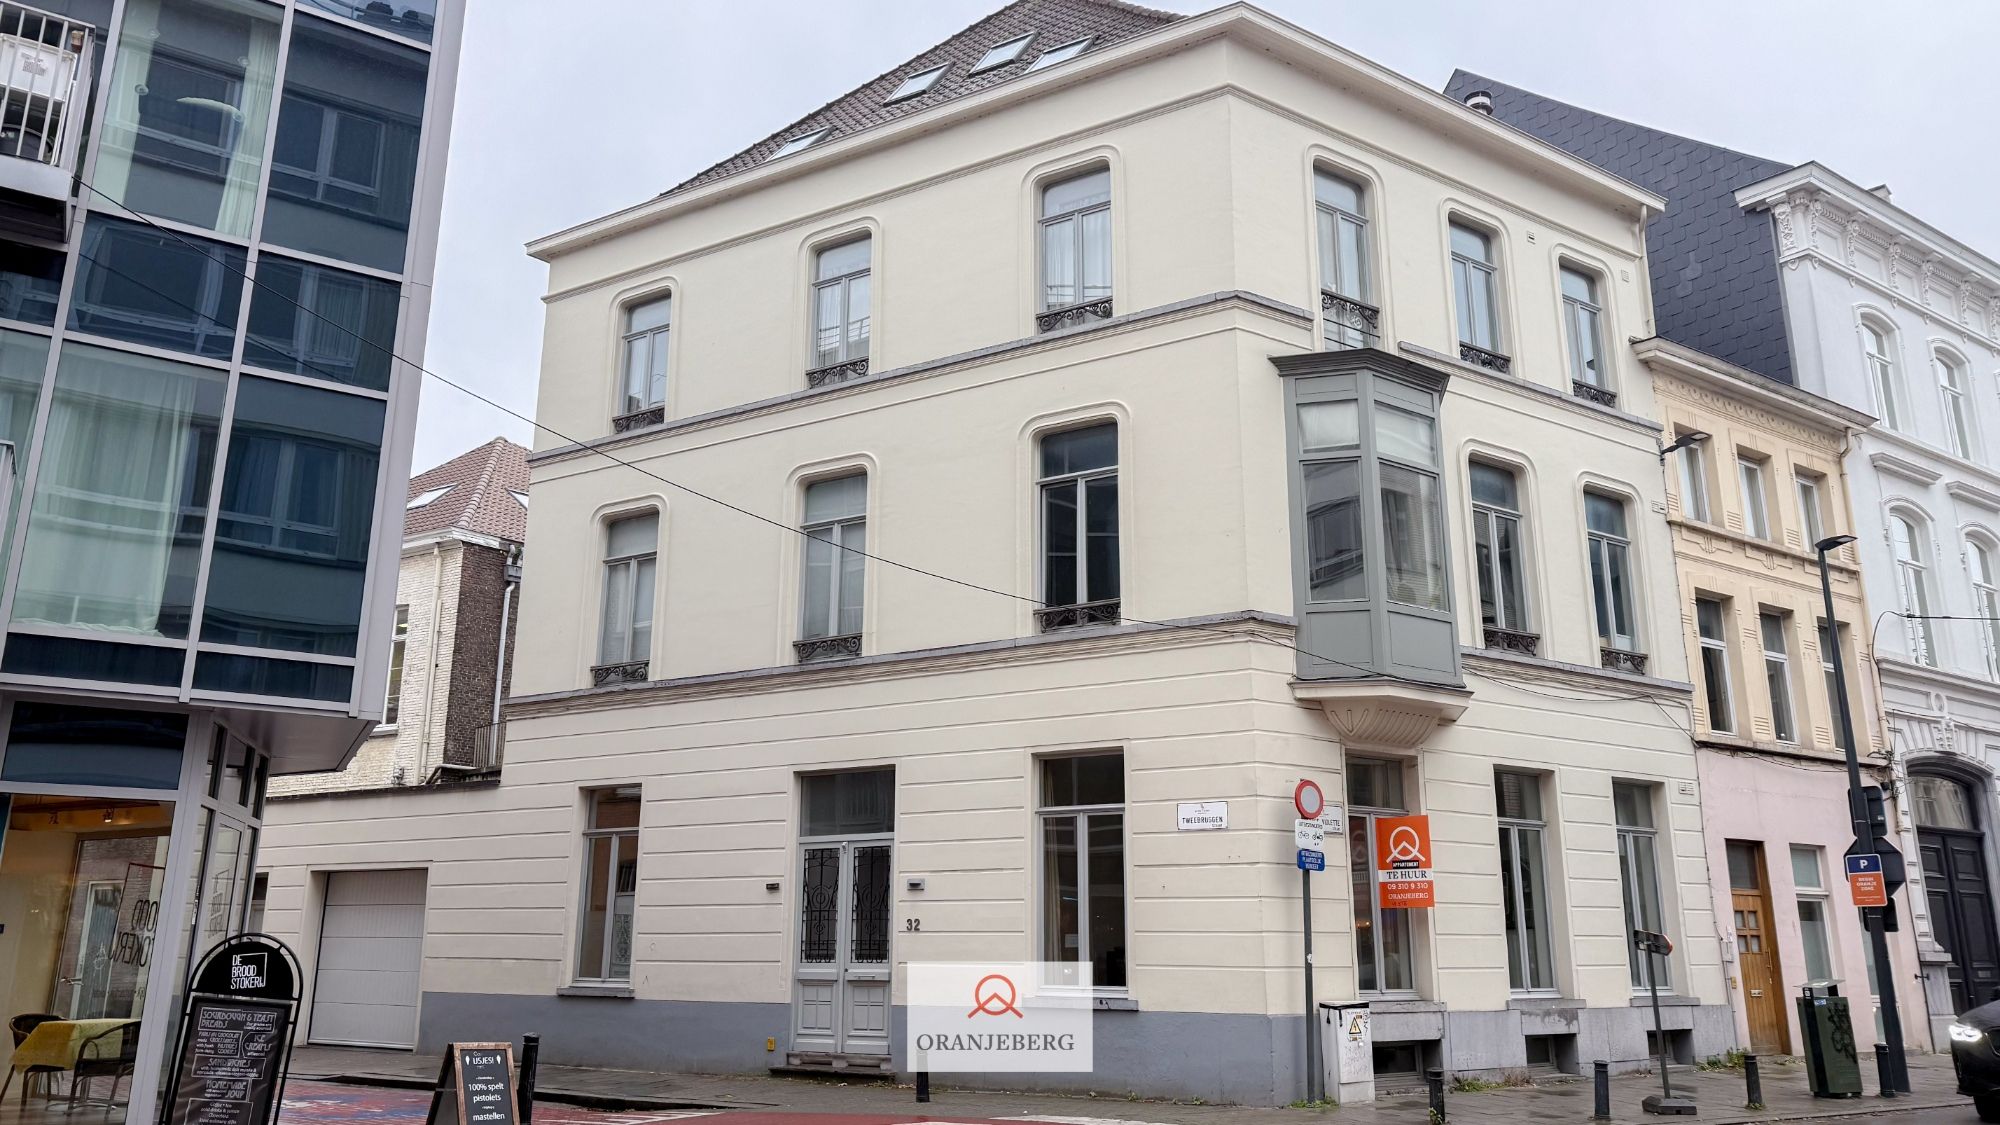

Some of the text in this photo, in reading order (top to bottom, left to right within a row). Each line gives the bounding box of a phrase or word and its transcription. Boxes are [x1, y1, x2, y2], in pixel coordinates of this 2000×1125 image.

[1860, 859, 1868, 869] P
[1386, 870, 1428, 880] TE HUUR
[1410, 882, 1415, 890] 9
[906, 918, 921, 932] 32
[232, 954, 243, 966] DE
[231, 965, 257, 978] BROOD
[230, 976, 266, 990] STOKERIJ
[202, 1011, 275, 1023] SOURDOUGH & YEAST
[201, 1019, 229, 1029] BREADS
[254, 1034, 266, 1042] ICE
[244, 1042, 273, 1051] CREAMS
[468, 1082, 505, 1091] 100% spelt
[225, 1090, 245, 1099] SOUP
[472, 1093, 502, 1104] pistolets
[472, 1112, 506, 1121] mastellen
